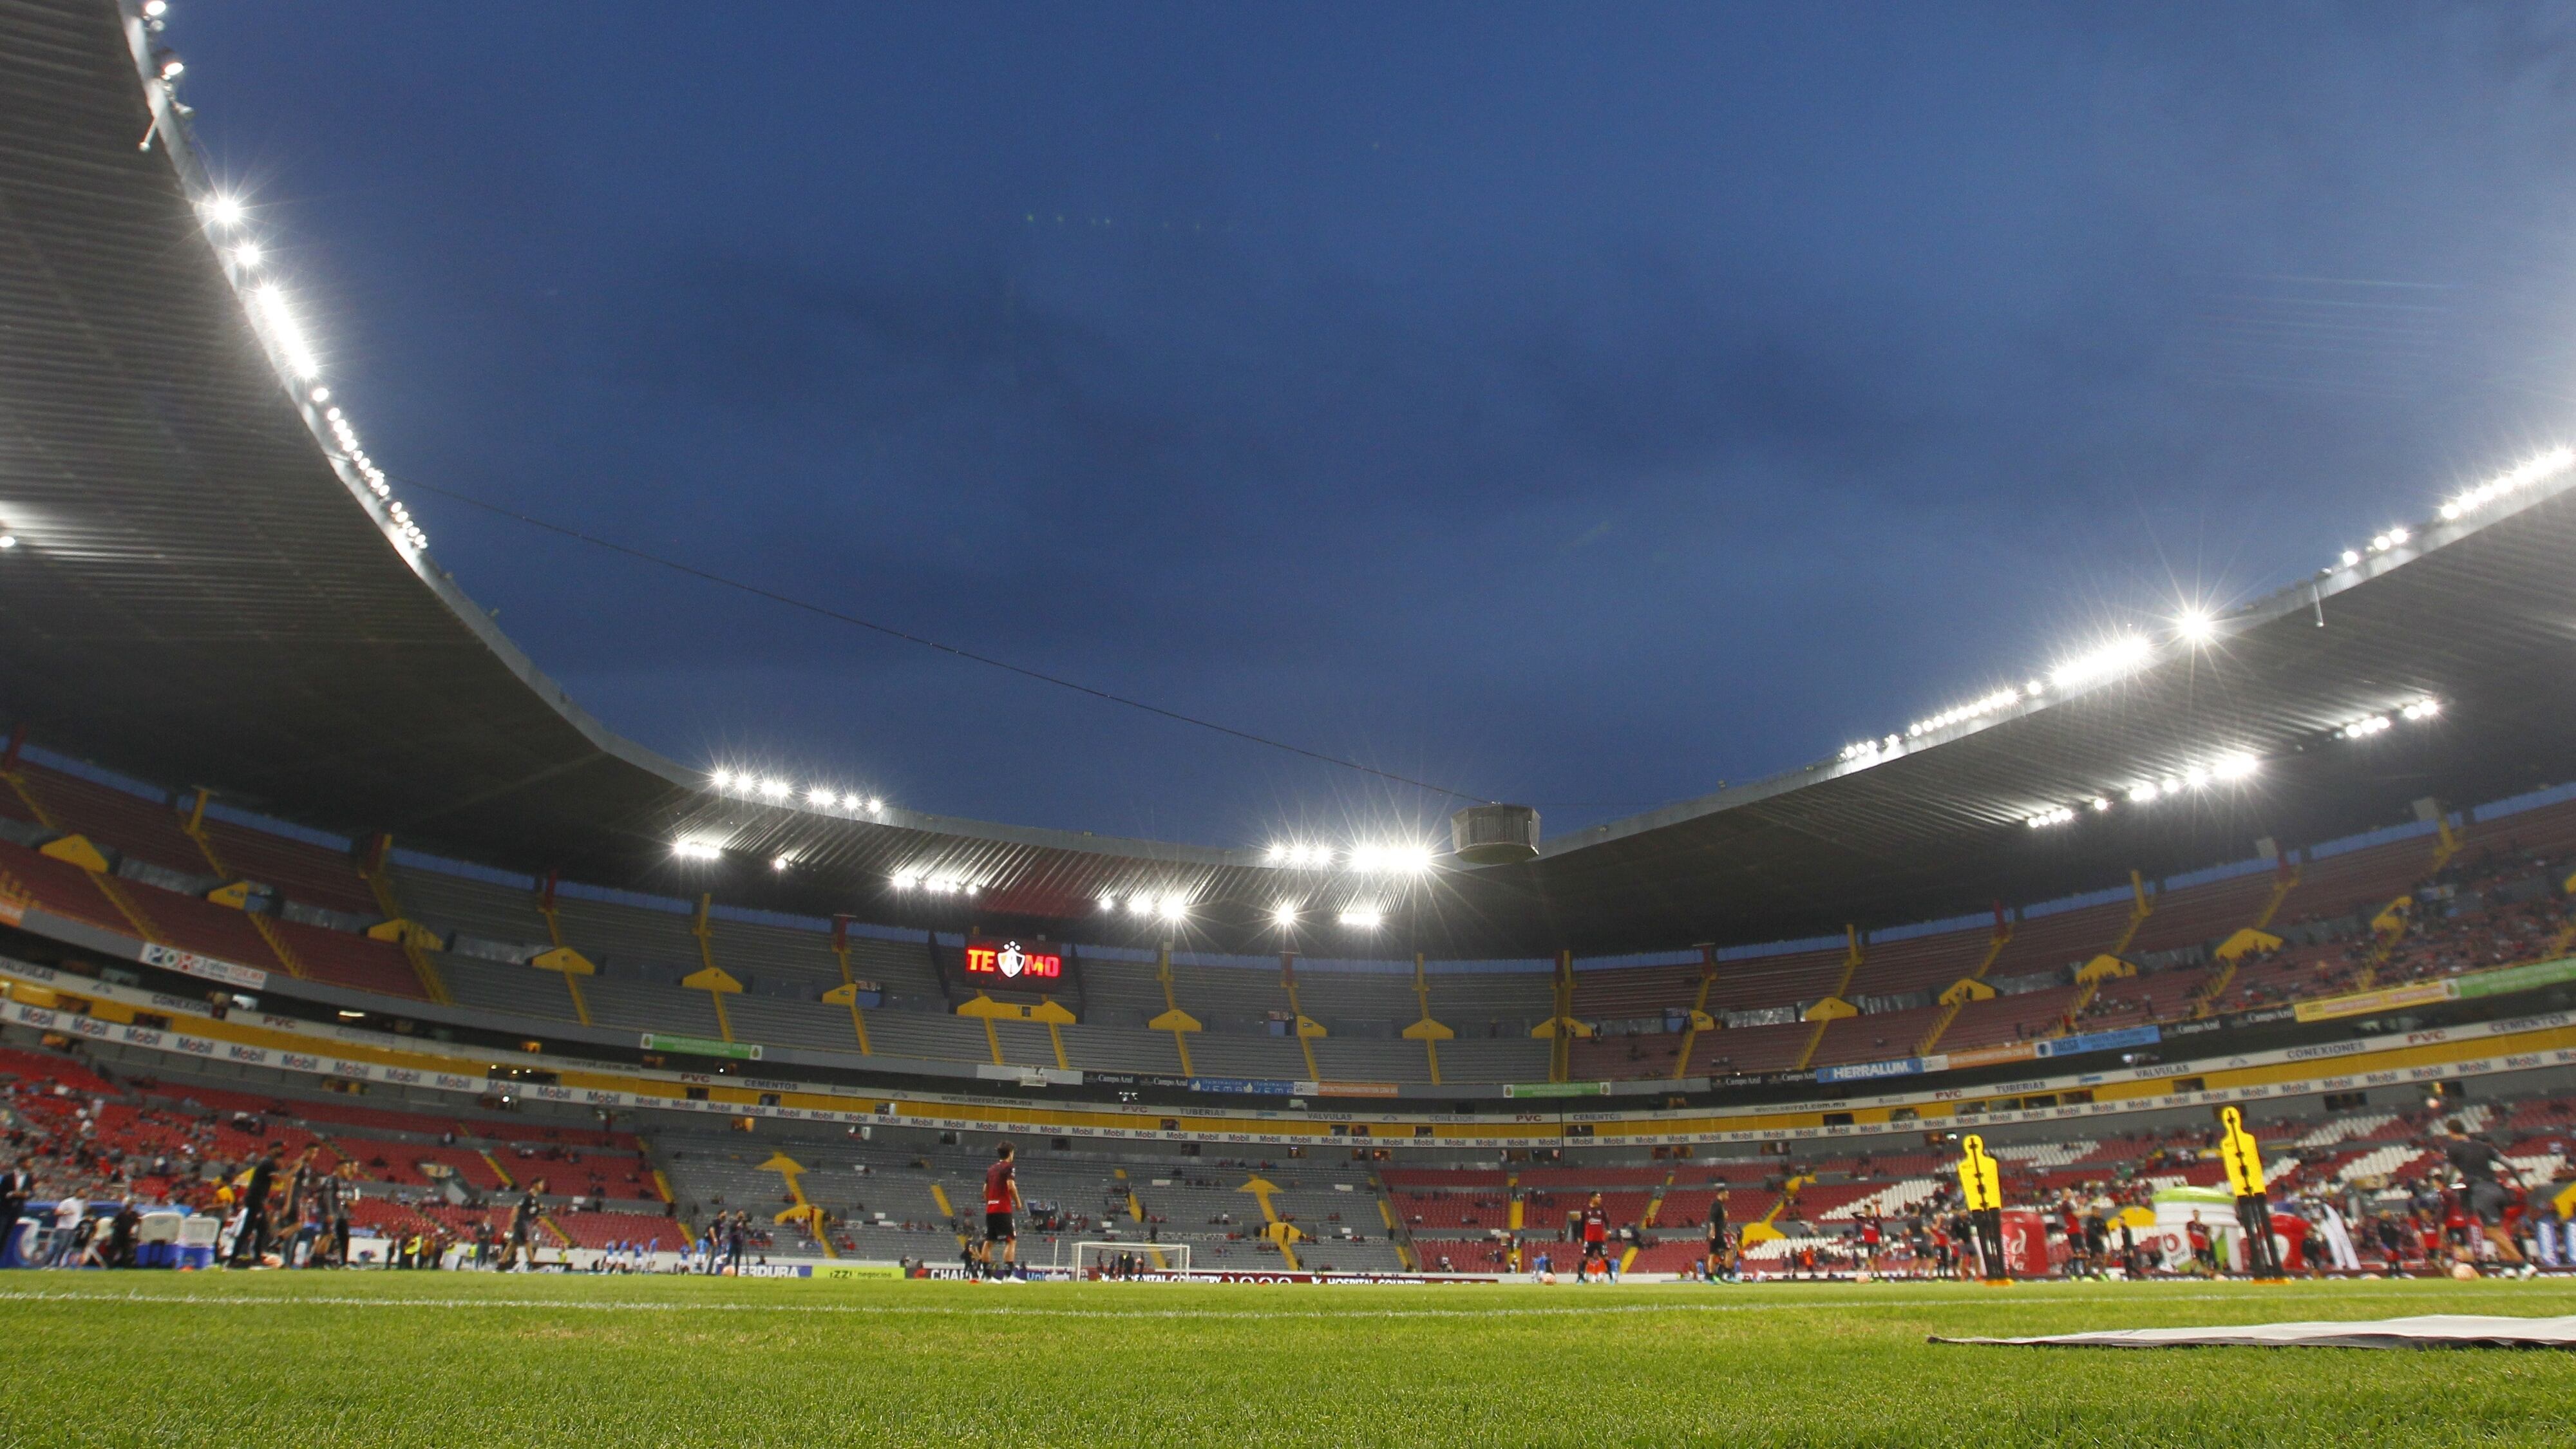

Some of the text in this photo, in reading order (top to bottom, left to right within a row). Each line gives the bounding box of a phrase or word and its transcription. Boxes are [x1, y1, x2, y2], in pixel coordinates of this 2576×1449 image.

[968, 949, 1059, 977] TE MO
[263, 1016, 297, 1028] PVC
[2408, 1030, 2446, 1045] PVC
[1834, 1061, 1908, 1080] HERRALUM
[681, 1073, 710, 1083] PVC
[1099, 1075, 1119, 1083] Campo
[1154, 1077, 1175, 1086] Campo
[1176, 1078, 1188, 1086] Azul
[744, 1079, 798, 1090] CEMENTOS
[1935, 1090, 1962, 1099] PVC
[1122, 1105, 1148, 1113] PVC
[537, 1086, 571, 1099] Mobil
[587, 1091, 620, 1104] Mobil
[635, 1097, 659, 1106] Mobil
[671, 1100, 696, 1109] Mobil
[708, 1103, 731, 1112] Mobil
[742, 1105, 766, 1115] Mobil
[777, 1108, 800, 1117] Mobil
[811, 1111, 834, 1121] Mobil
[845, 1113, 867, 1122] Mobil
[877, 1115, 900, 1124] Mobil
[911, 1117, 933, 1126] Mobil
[943, 1120, 965, 1129] Mobil
[976, 1122, 998, 1131] Mobil
[1009, 1124, 1030, 1132] Mobil
[1040, 1126, 1061, 1134] Mobil
[1072, 1127, 1094, 1135] Mobil
[1104, 1129, 1124, 1137] Mobil
[1167, 1132, 1188, 1140] Mobil
[1198, 1133, 1219, 1141] Mobil
[1228, 1134, 1249, 1142] Mobil
[1260, 1135, 1280, 1143] Mobil
[1291, 1135, 1311, 1144] Mobil
[1732, 1132, 1753, 1140] Mobil
[1764, 1130, 1785, 1139] Mobil
[1861, 1125, 1882, 1133] Mobil
[1893, 1122, 1914, 1131] Mobil
[1924, 1119, 1946, 1128] Mobil
[1956, 1115, 1978, 1125] Mobil
[1989, 1112, 2012, 1122] Mobil
[2023, 1110, 2046, 1119] Mobil
[2057, 1106, 2081, 1116] Mobil
[2092, 1103, 2116, 1113] Mobil
[2127, 1099, 2152, 1109] Mobil
[2164, 1095, 2190, 1105] Mobil
[2202, 1091, 2228, 1101] Mobil
[2241, 1086, 2269, 1097] Mobil
[738, 1265, 800, 1278] ERDURA
